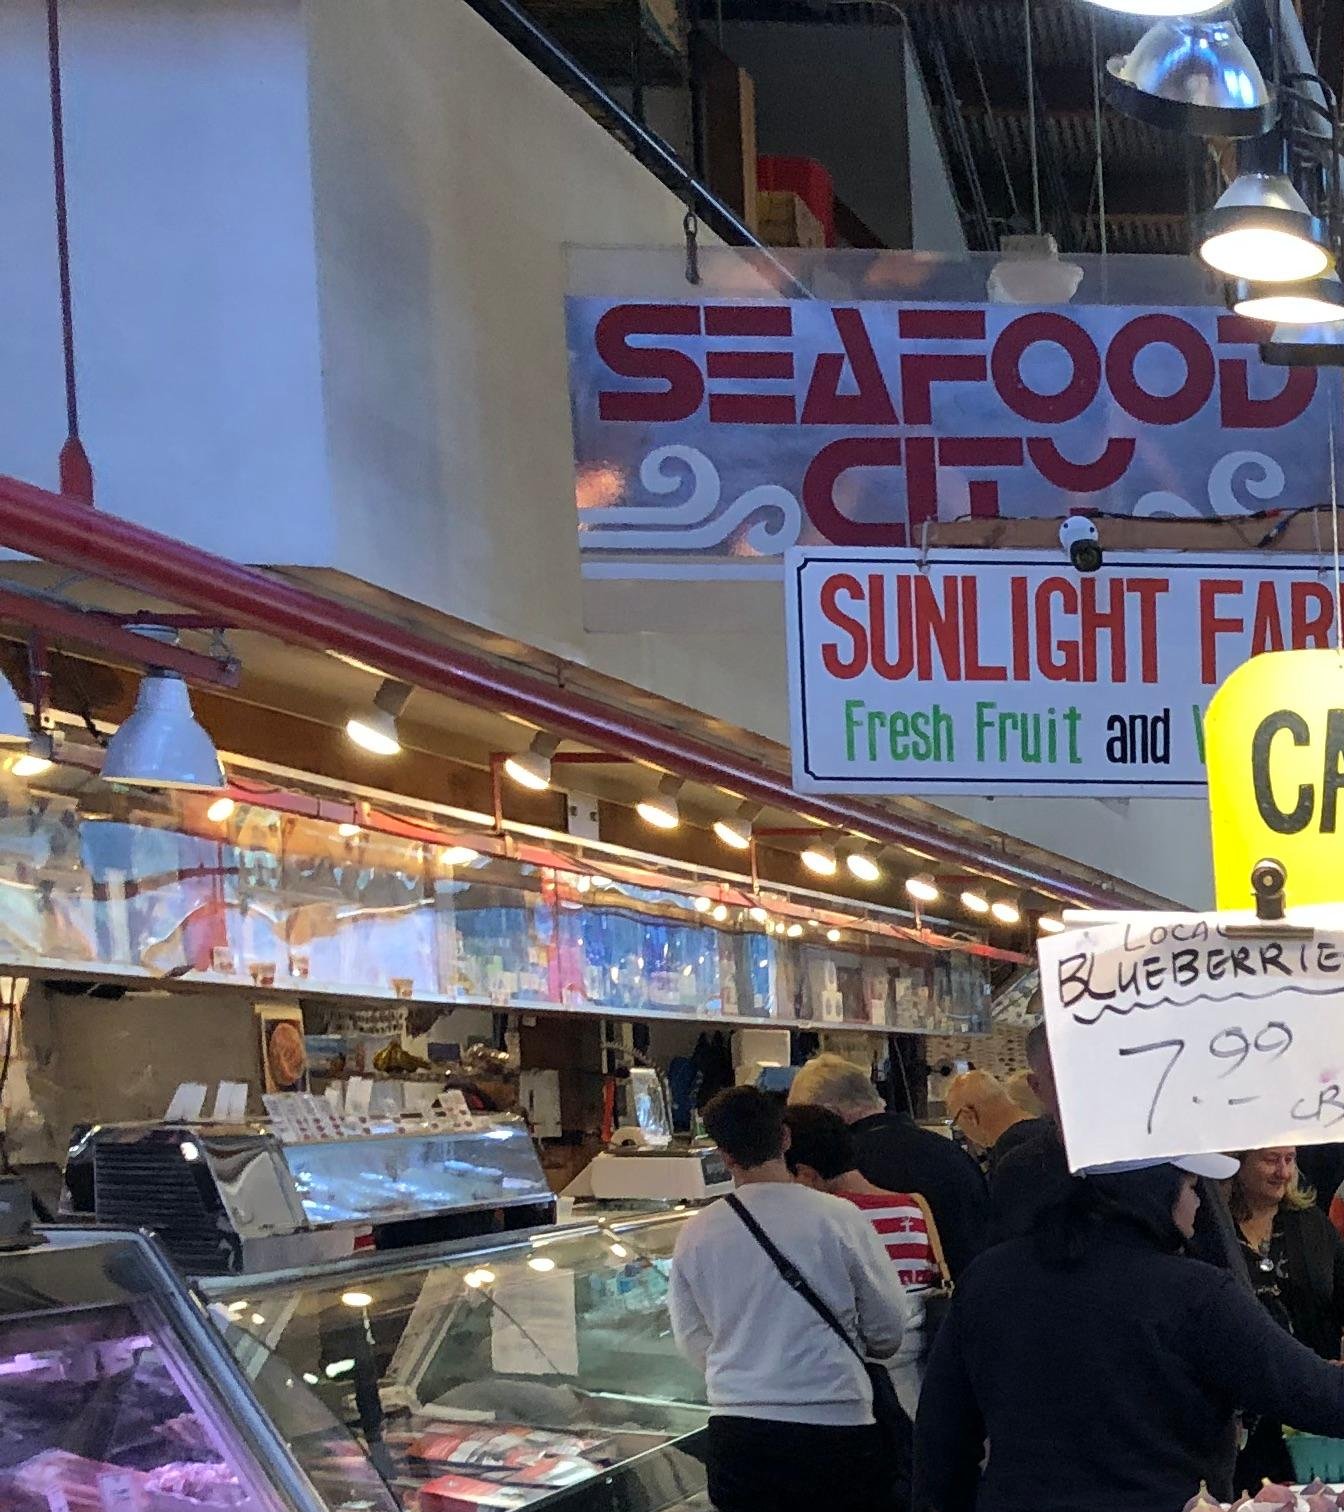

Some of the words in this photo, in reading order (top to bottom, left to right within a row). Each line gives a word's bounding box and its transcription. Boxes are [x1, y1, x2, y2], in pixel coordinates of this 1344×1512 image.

[595, 304, 1318, 429] SEAFOOD
[820, 573, 1168, 682] SUNLIGHT
[844, 700, 954, 763] Fresh
[976, 702, 1083, 765] Fruit
[1106, 708, 1171, 765] and
